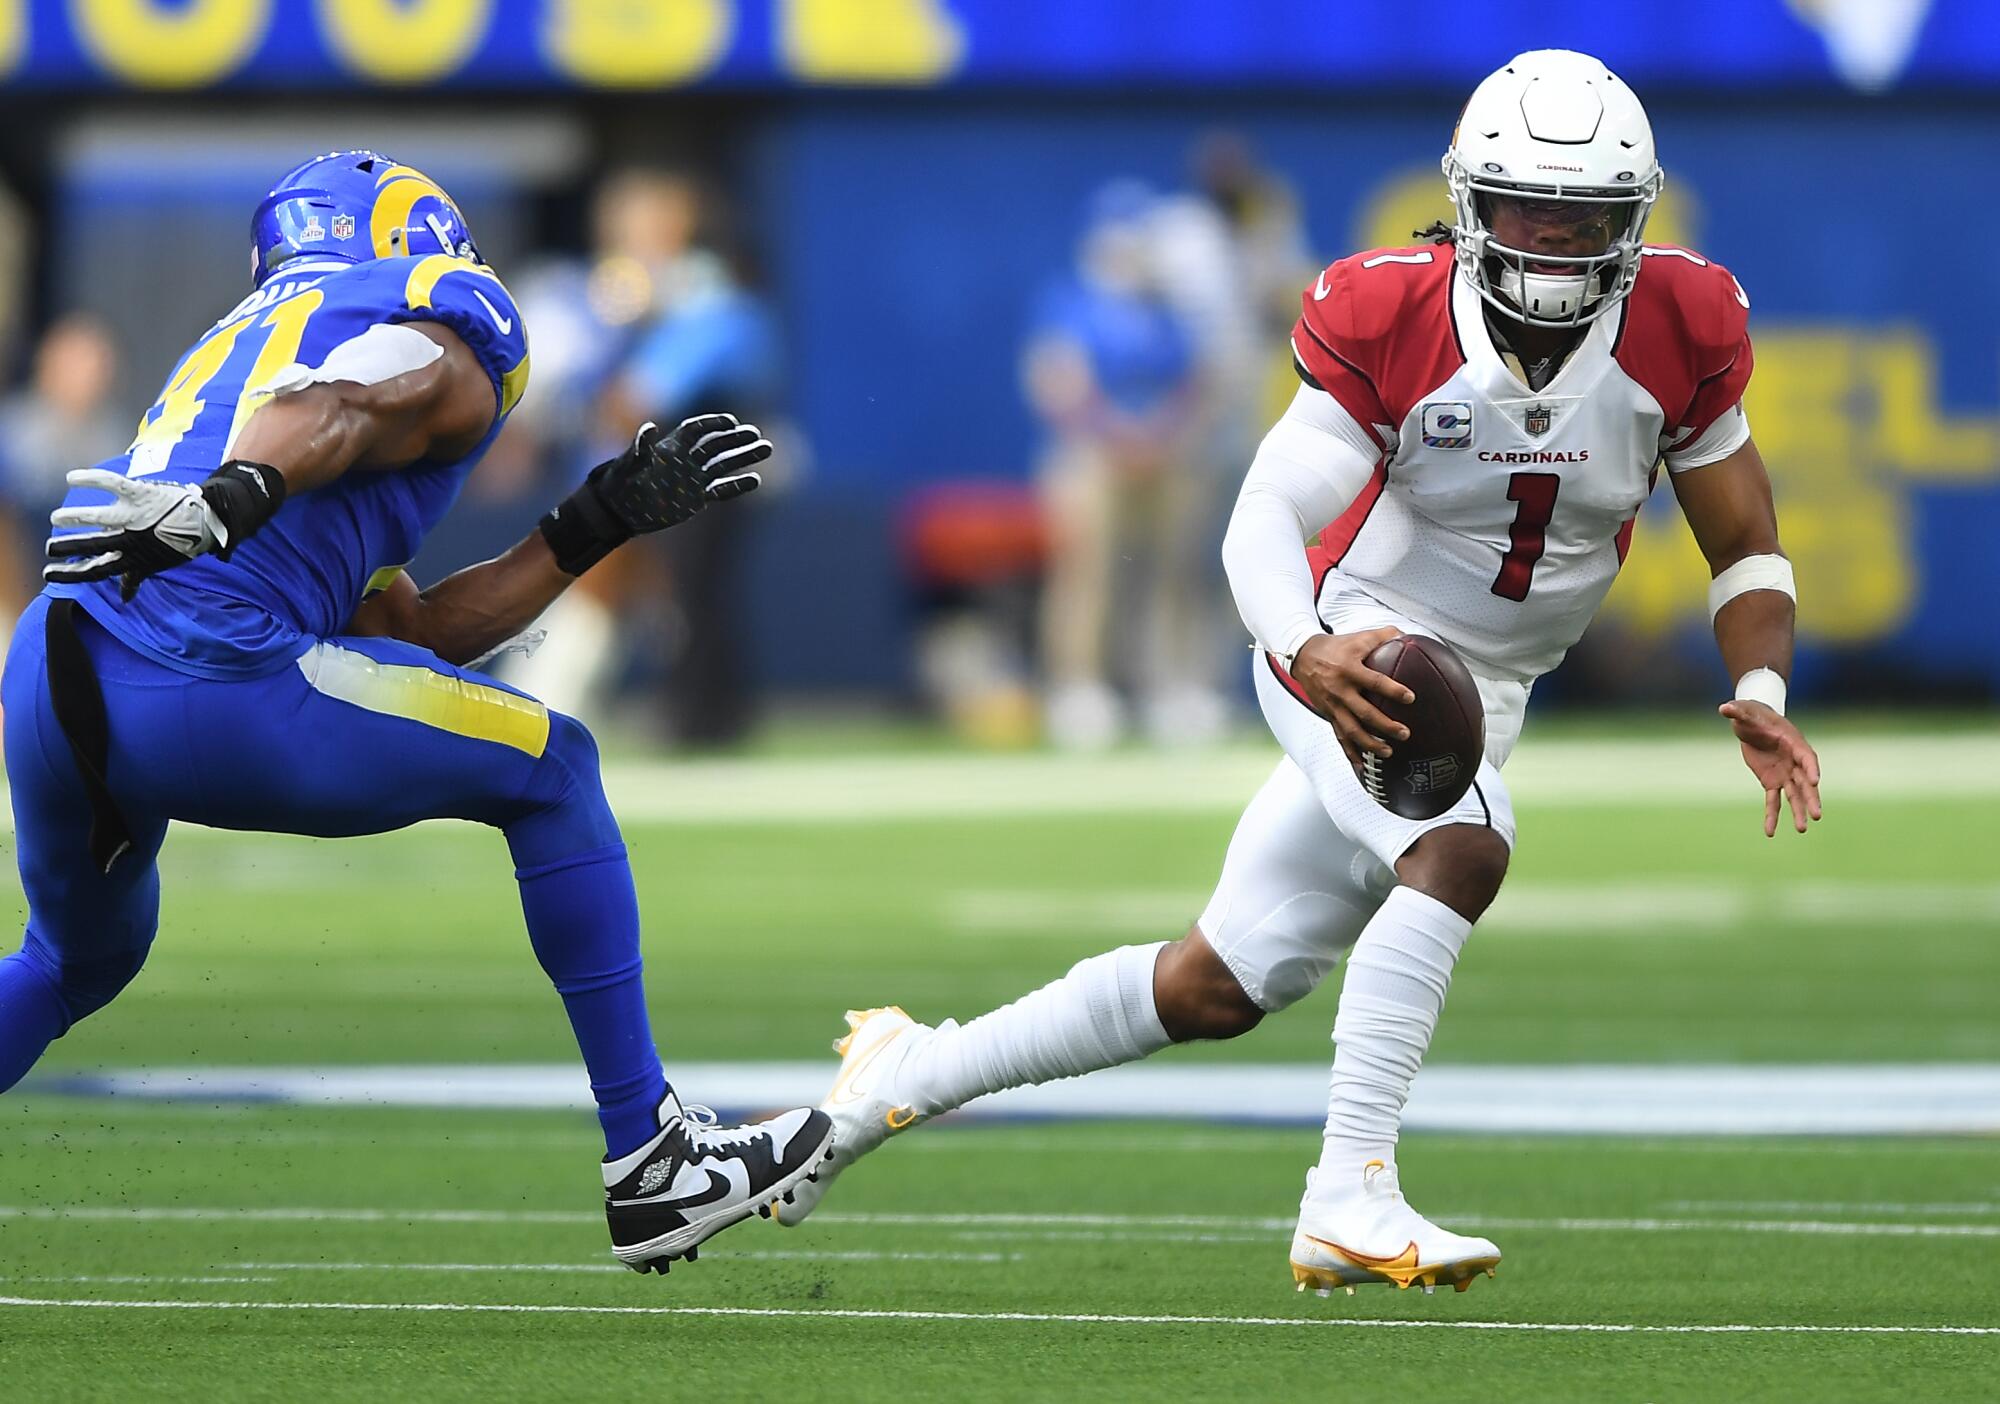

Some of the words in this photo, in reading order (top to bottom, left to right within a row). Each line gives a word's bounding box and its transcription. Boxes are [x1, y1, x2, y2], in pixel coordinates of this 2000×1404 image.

[1536, 163, 1583, 173] CARDINALS
[1361, 250, 1434, 270] 1
[125, 288, 325, 478] 41
[1424, 404, 1471, 438] C
[1477, 450, 1589, 464] CARDINALS
[1490, 472, 1560, 602] 1
